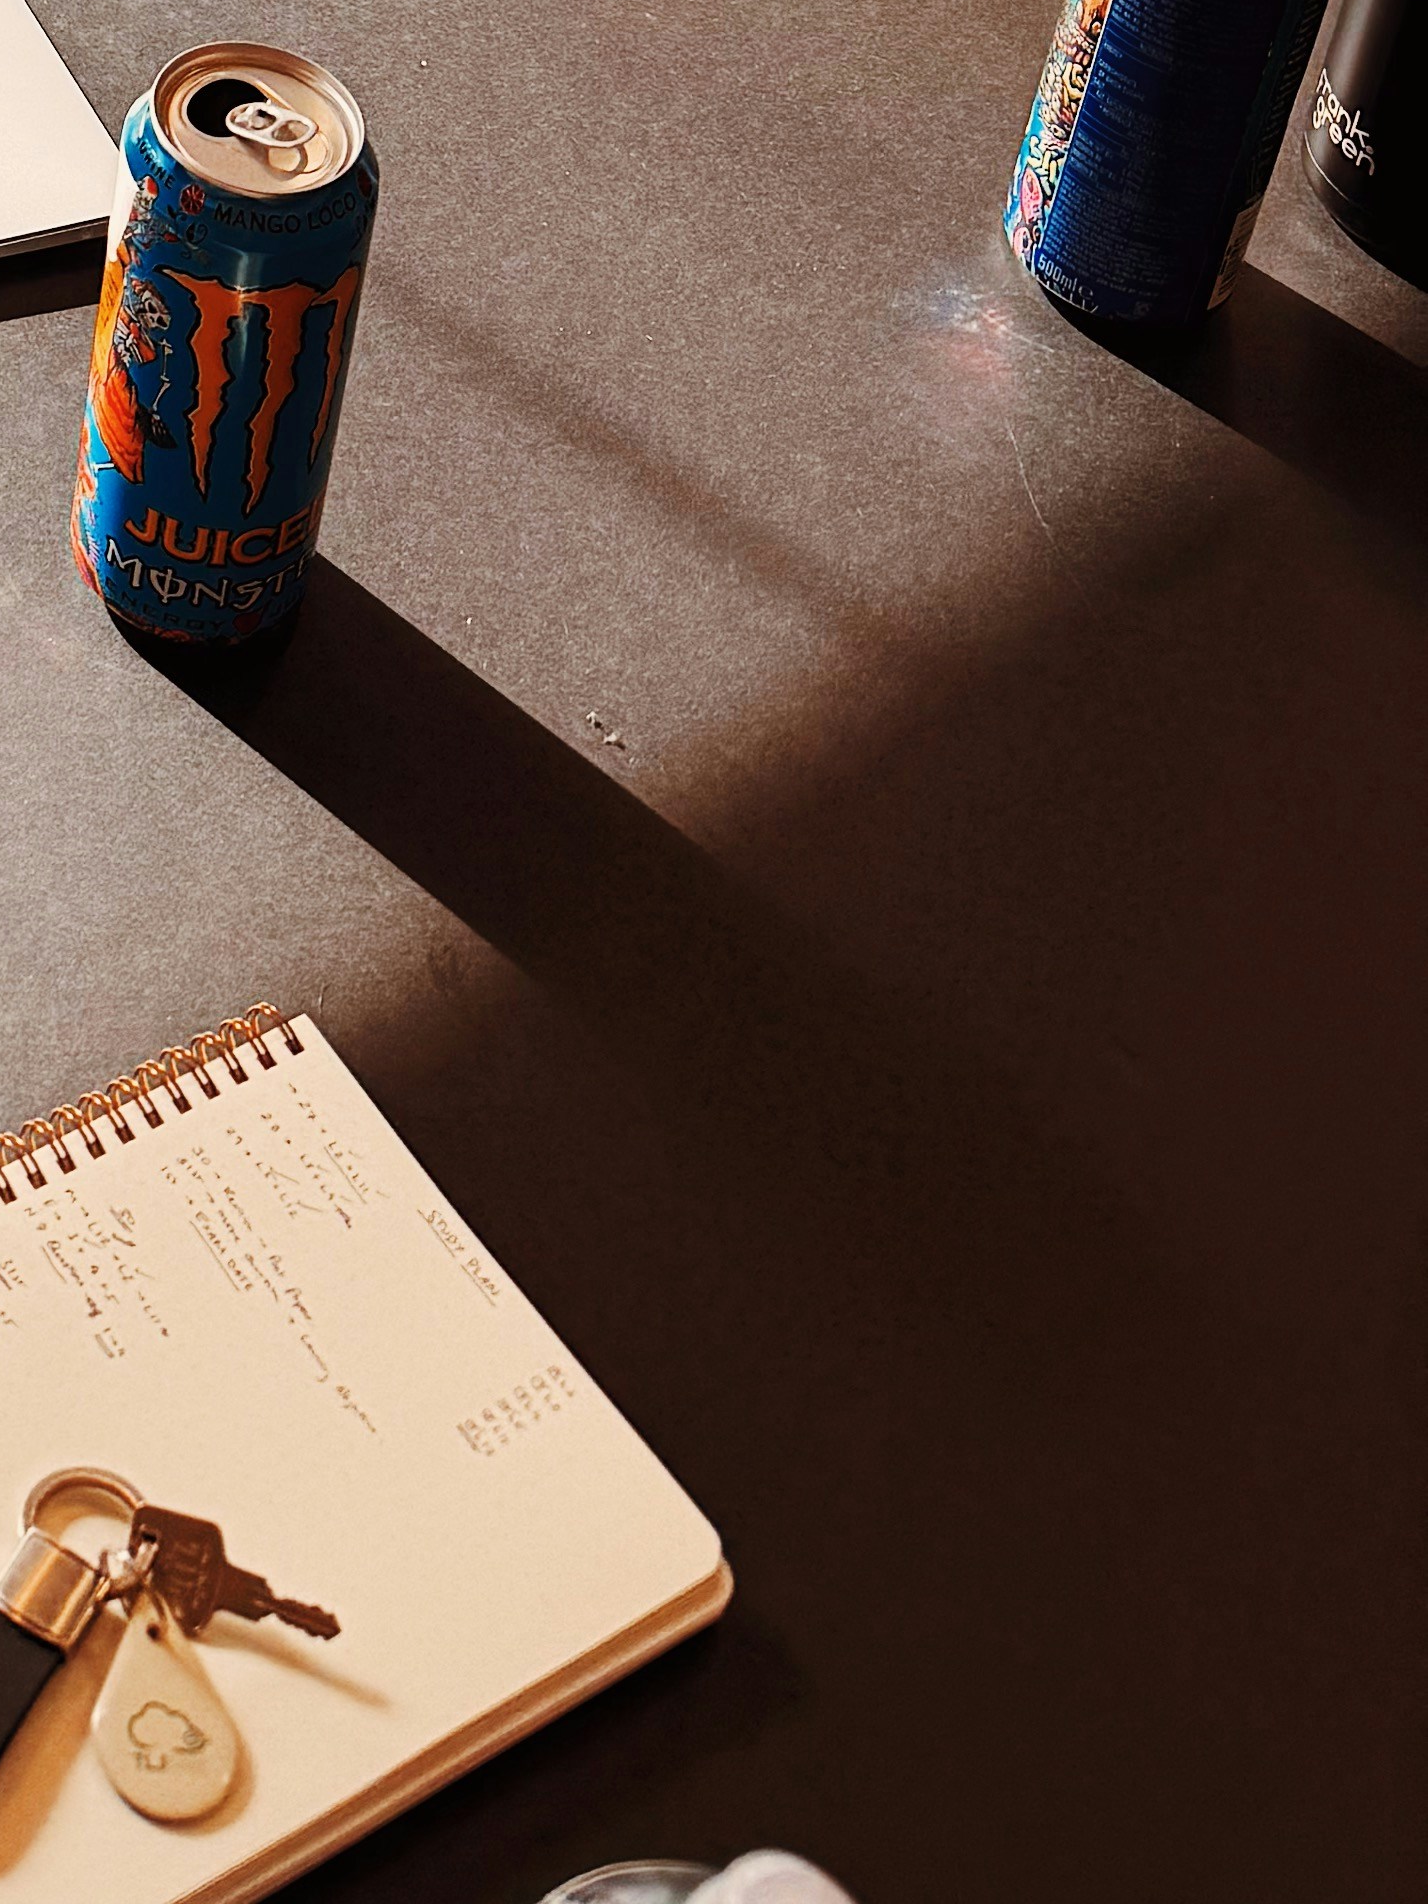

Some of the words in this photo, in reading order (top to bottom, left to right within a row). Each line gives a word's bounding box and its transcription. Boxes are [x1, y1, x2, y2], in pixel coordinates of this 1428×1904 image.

[1312, 96, 1376, 176] green
[213, 201, 301, 235] MANGO
[306, 192, 358, 232] LOCO
[425, 1209, 465, 1252] STUDY
